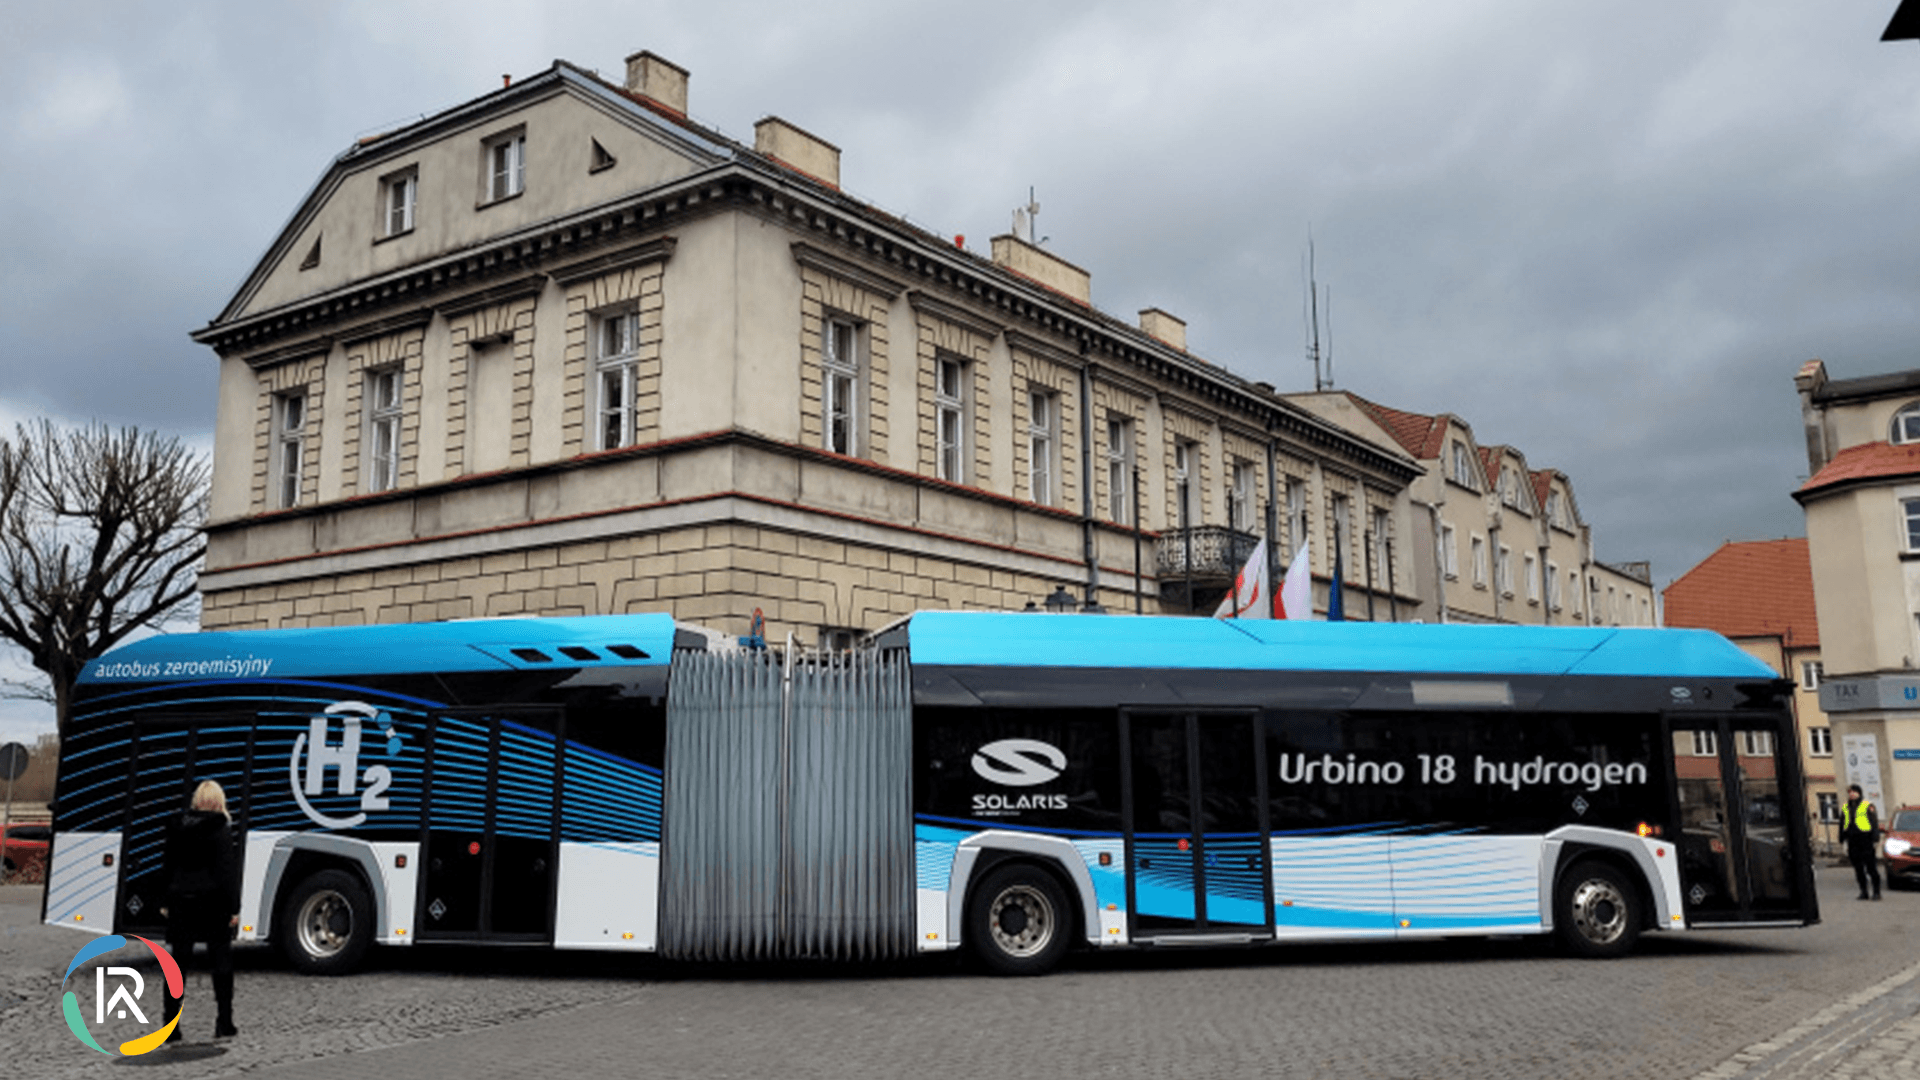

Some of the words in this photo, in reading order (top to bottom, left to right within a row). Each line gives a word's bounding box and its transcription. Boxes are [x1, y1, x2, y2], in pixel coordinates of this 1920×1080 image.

[95, 660, 160, 678] autobus
[163, 654, 273, 677] zeroemisyjny
[1280, 753, 1405, 784] Urbino
[1418, 754, 1456, 784] 18
[1474, 755, 1647, 791] hydrogen
[972, 794, 1068, 809] SOLARIS
